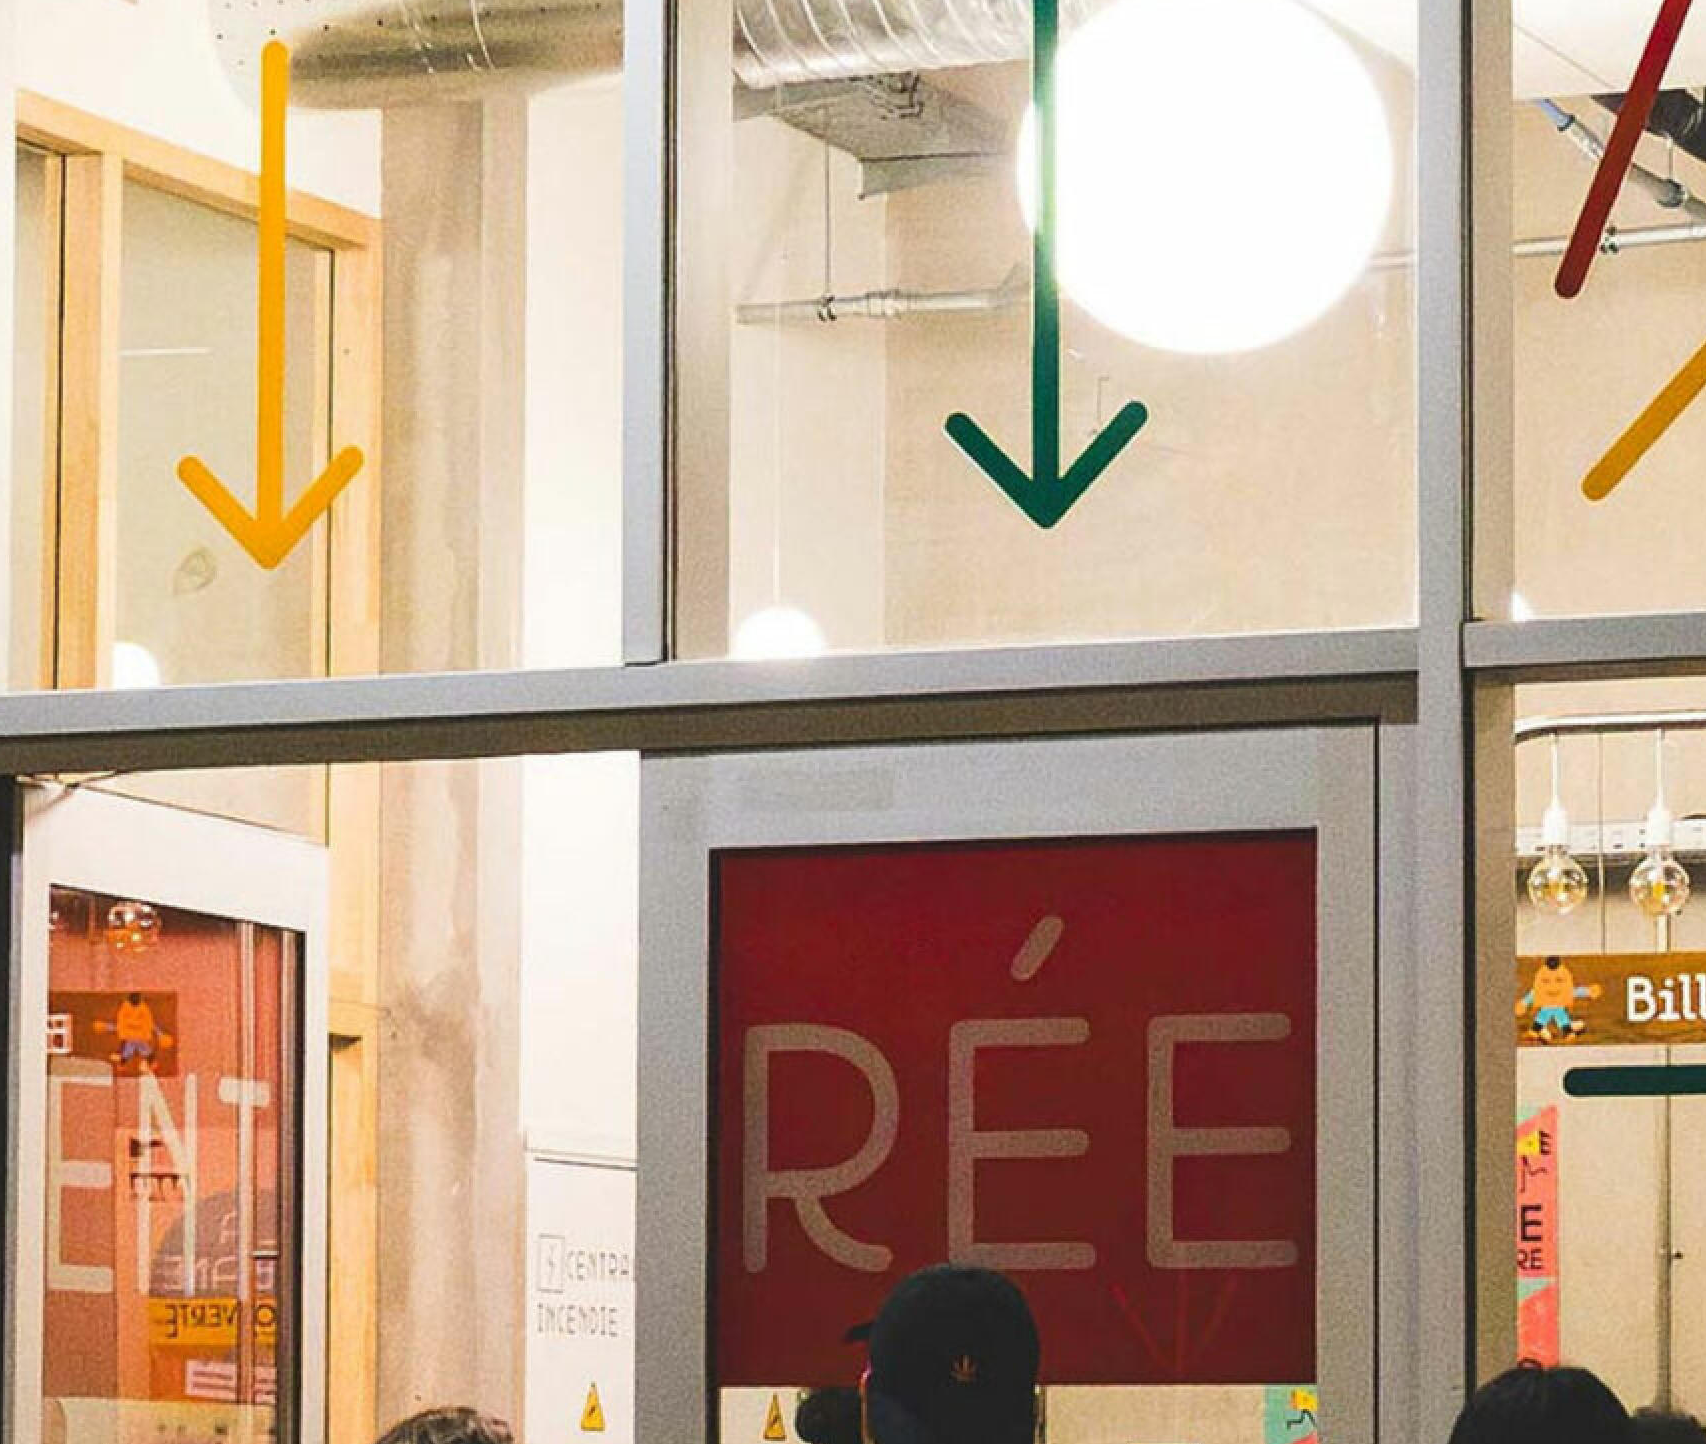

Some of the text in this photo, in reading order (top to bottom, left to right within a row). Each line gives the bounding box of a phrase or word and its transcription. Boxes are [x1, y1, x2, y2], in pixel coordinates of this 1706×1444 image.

[47, 915, 1298, 1295] ENT RÉE
[565, 1250, 634, 1281] CENTRA
[536, 1302, 619, 1337] INCENDIE
